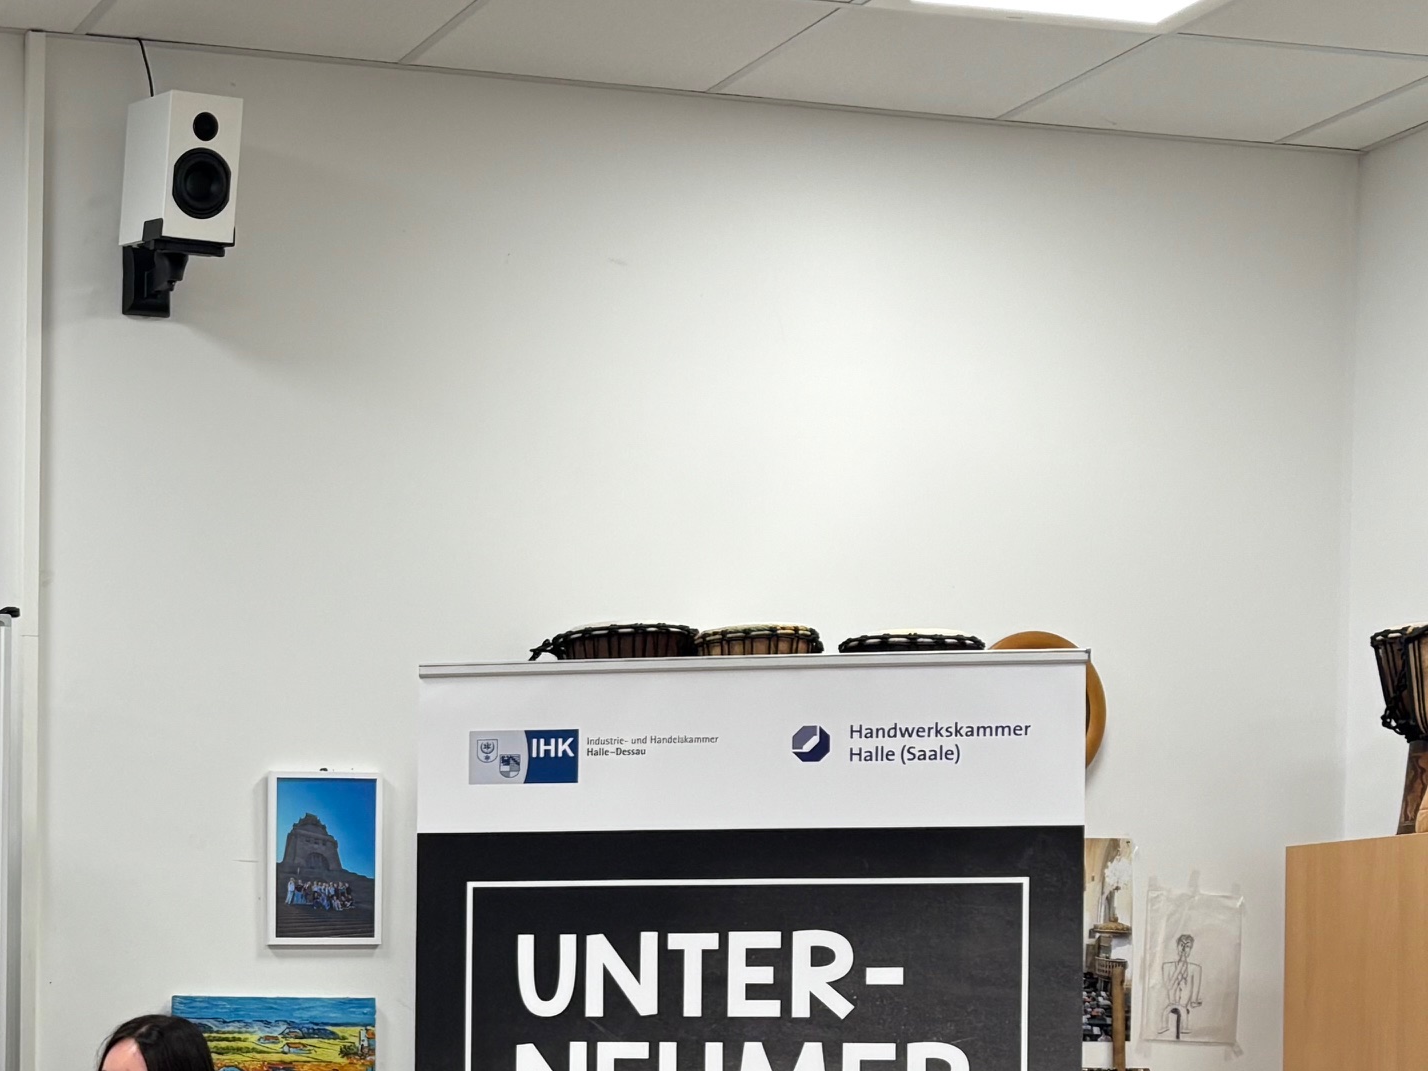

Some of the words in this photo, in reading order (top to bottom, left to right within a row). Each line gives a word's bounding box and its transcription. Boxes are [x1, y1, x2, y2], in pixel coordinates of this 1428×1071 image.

[587, 737, 628, 745] Industrie-
[631, 736, 647, 745] und
[650, 735, 719, 744] Handelskammer
[850, 722, 1031, 739] Handwerkskammer
[531, 738, 574, 758] IHK
[849, 746, 896, 762] Halle
[900, 744, 961, 764] (Saale)
[516, 929, 904, 1019] UNTER-
